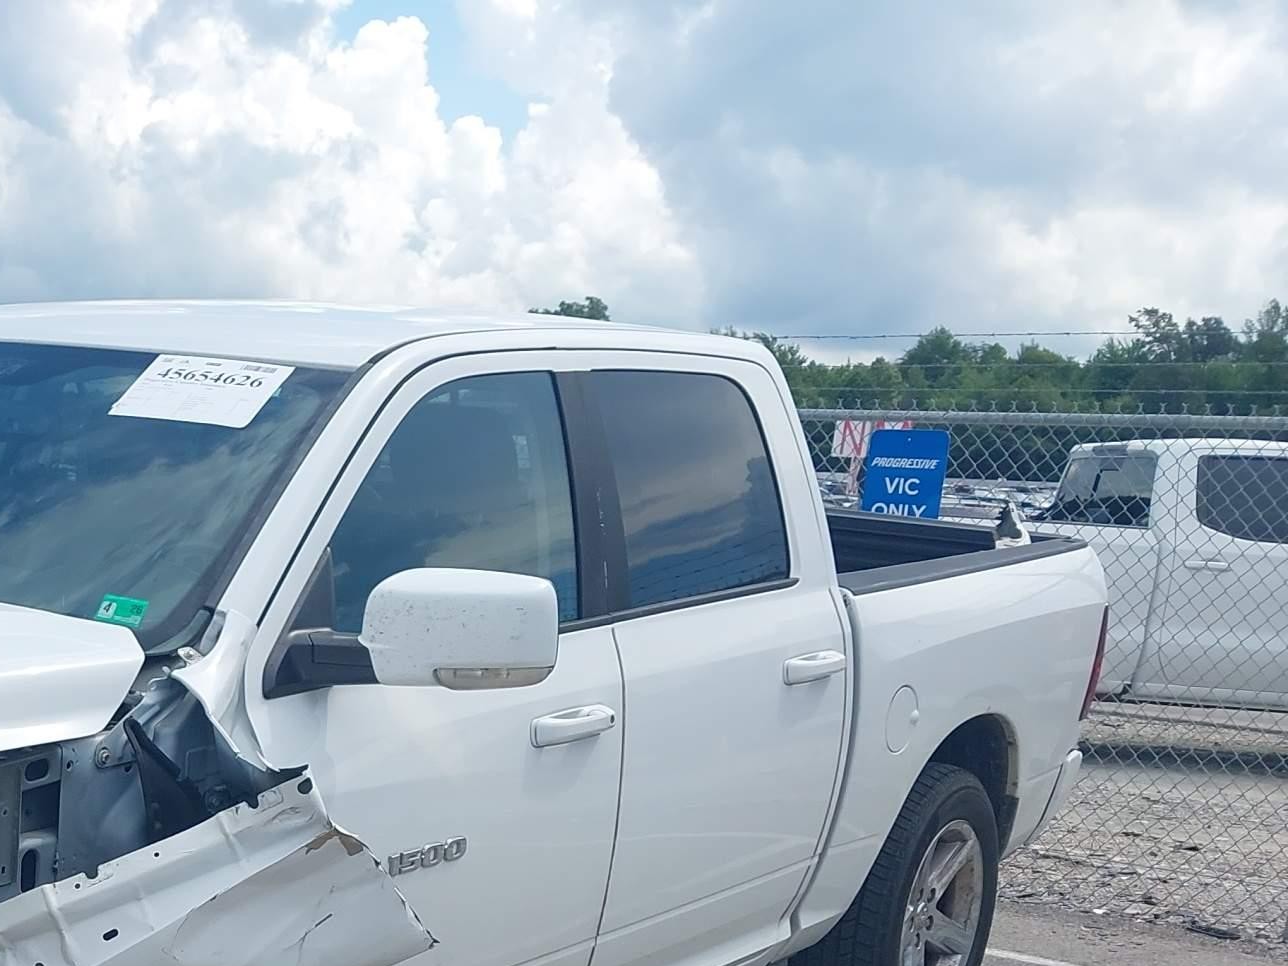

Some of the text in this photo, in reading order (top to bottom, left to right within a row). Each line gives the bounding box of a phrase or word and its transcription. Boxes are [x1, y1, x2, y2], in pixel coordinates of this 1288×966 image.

[157, 367, 264, 388] 45654626
[871, 456, 940, 470] PROGRESSIVE
[885, 477, 921, 495] VIC
[103, 602, 112, 613] 4
[387, 835, 467, 878] 1500
